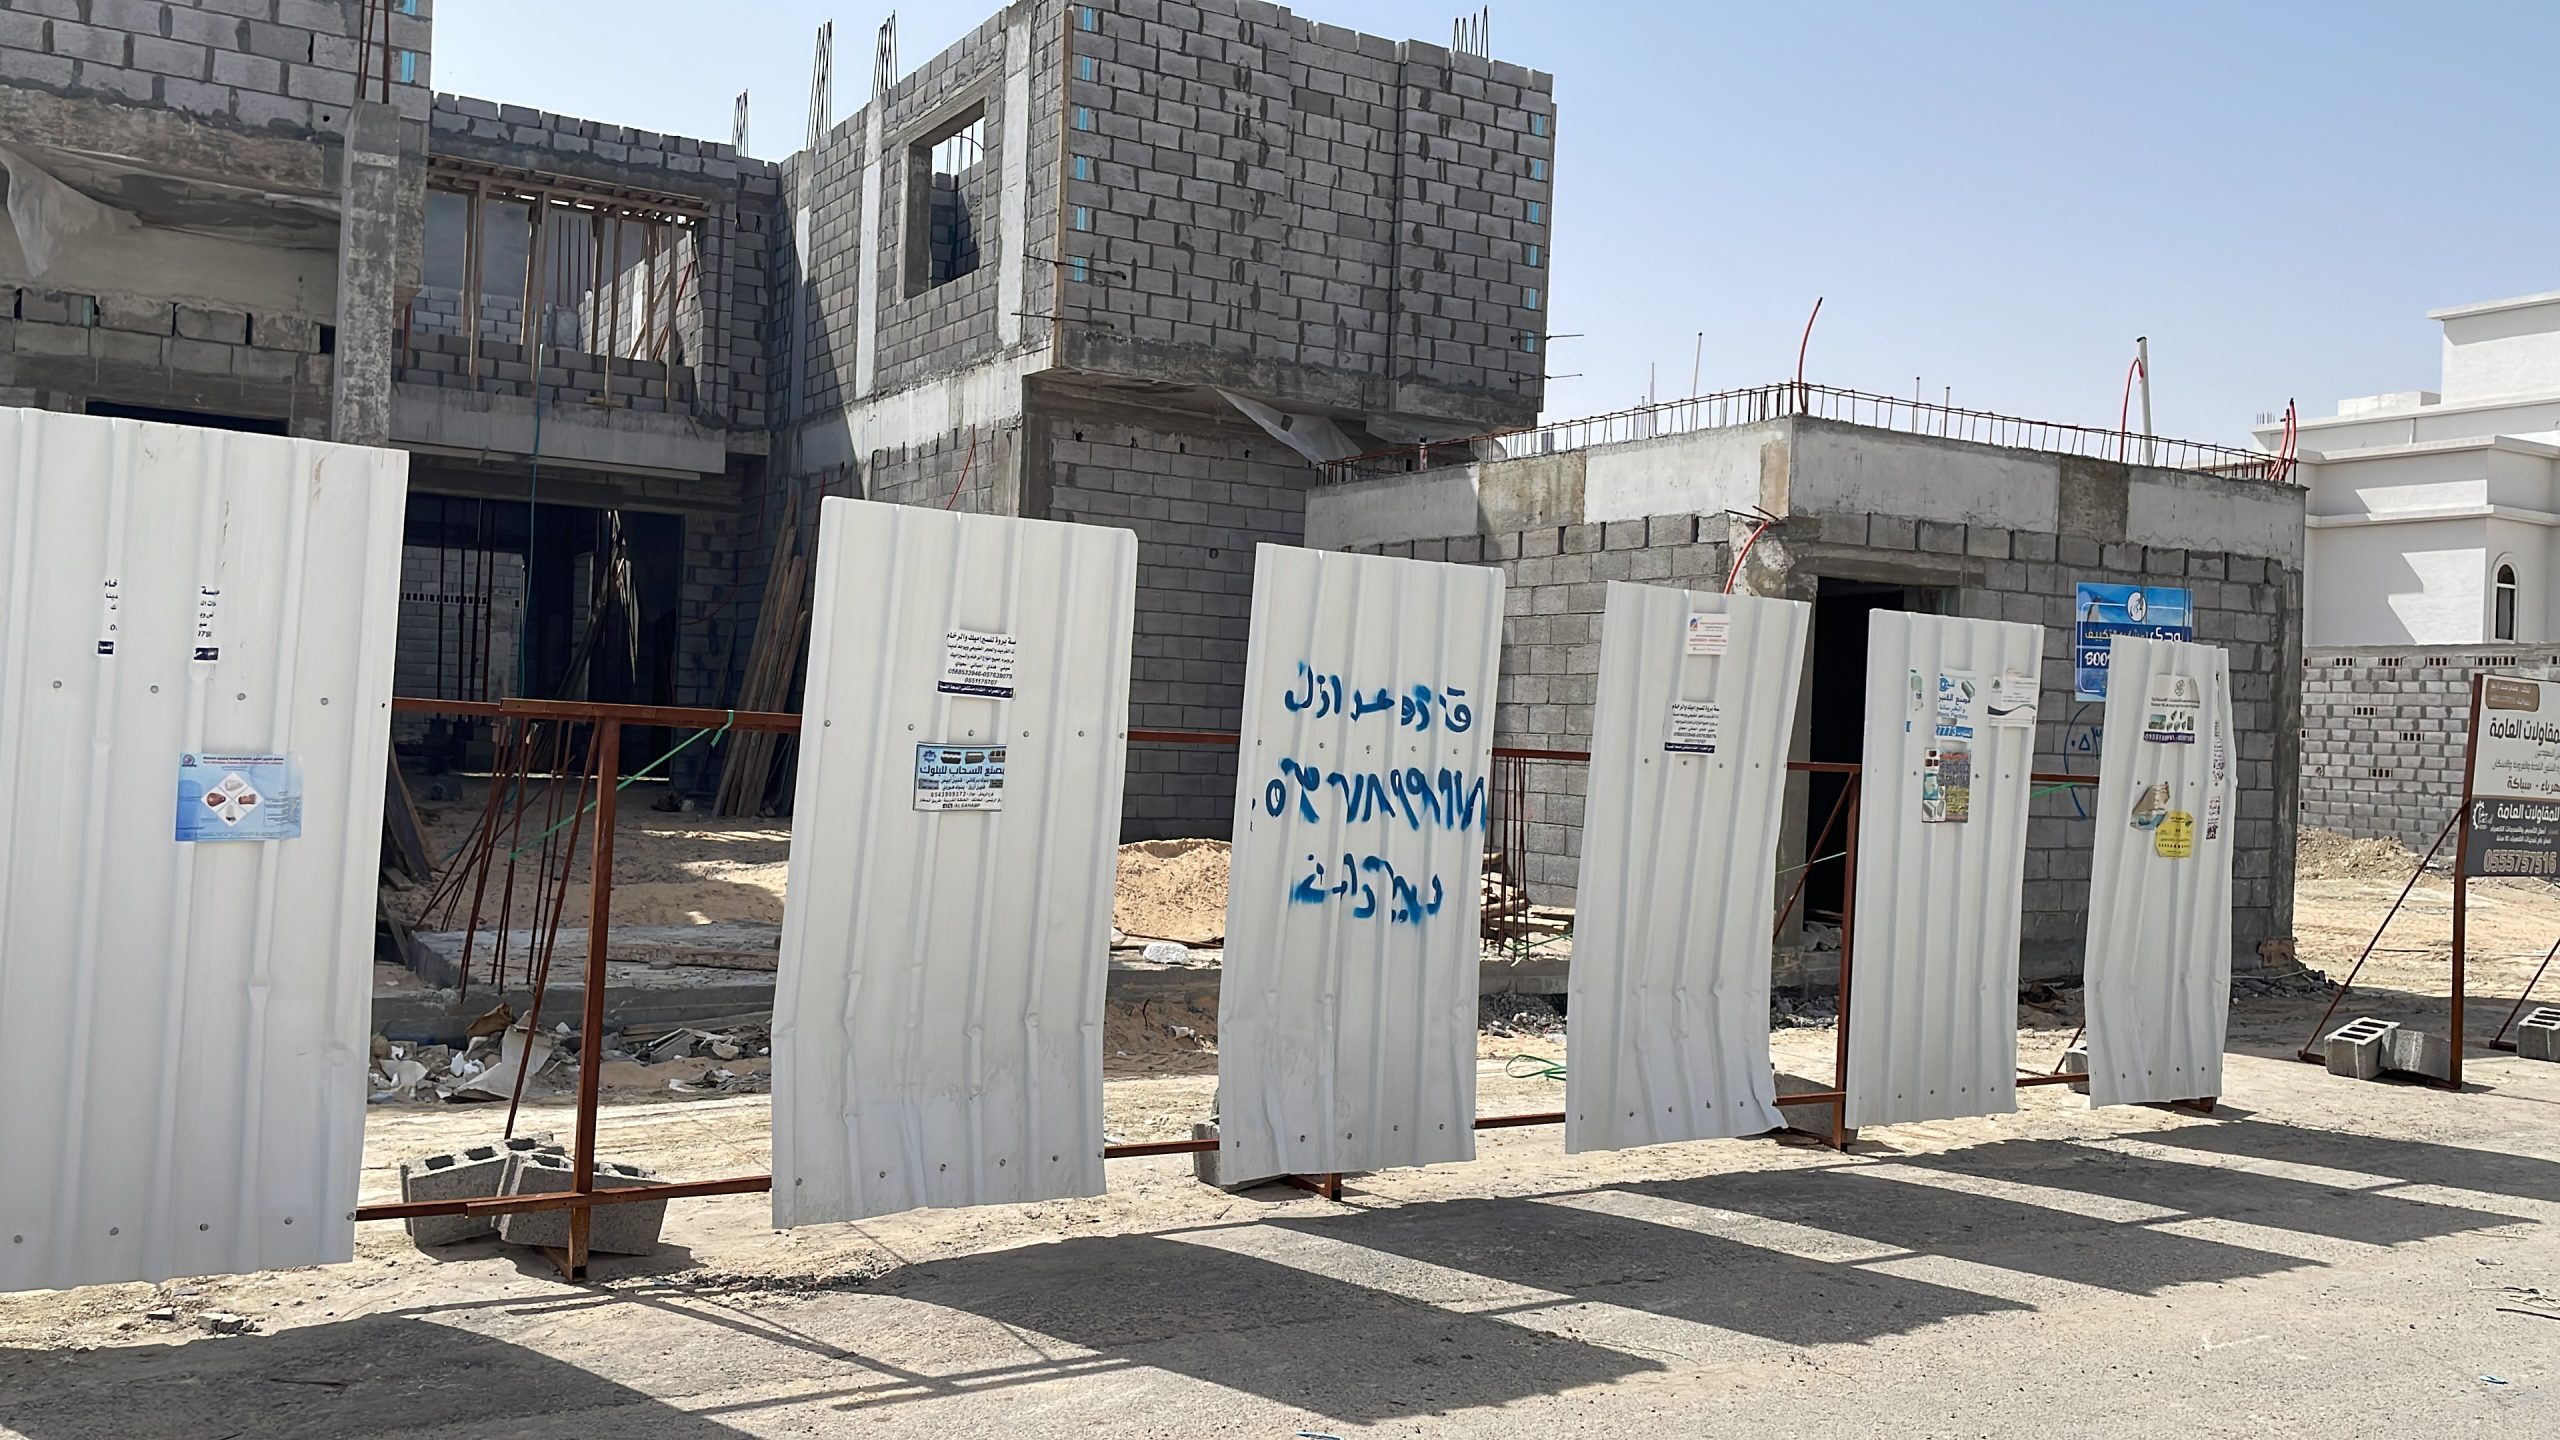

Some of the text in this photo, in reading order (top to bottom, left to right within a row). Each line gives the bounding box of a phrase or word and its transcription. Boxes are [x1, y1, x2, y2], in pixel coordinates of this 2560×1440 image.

[2490, 717, 2560, 747] مقاولات العامة
[949, 766, 983, 777] السحاب
[2507, 776, 2532, 794] سباكة
[2497, 803, 2524, 820] العامة
[2484, 848, 2557, 874] 0555757516
